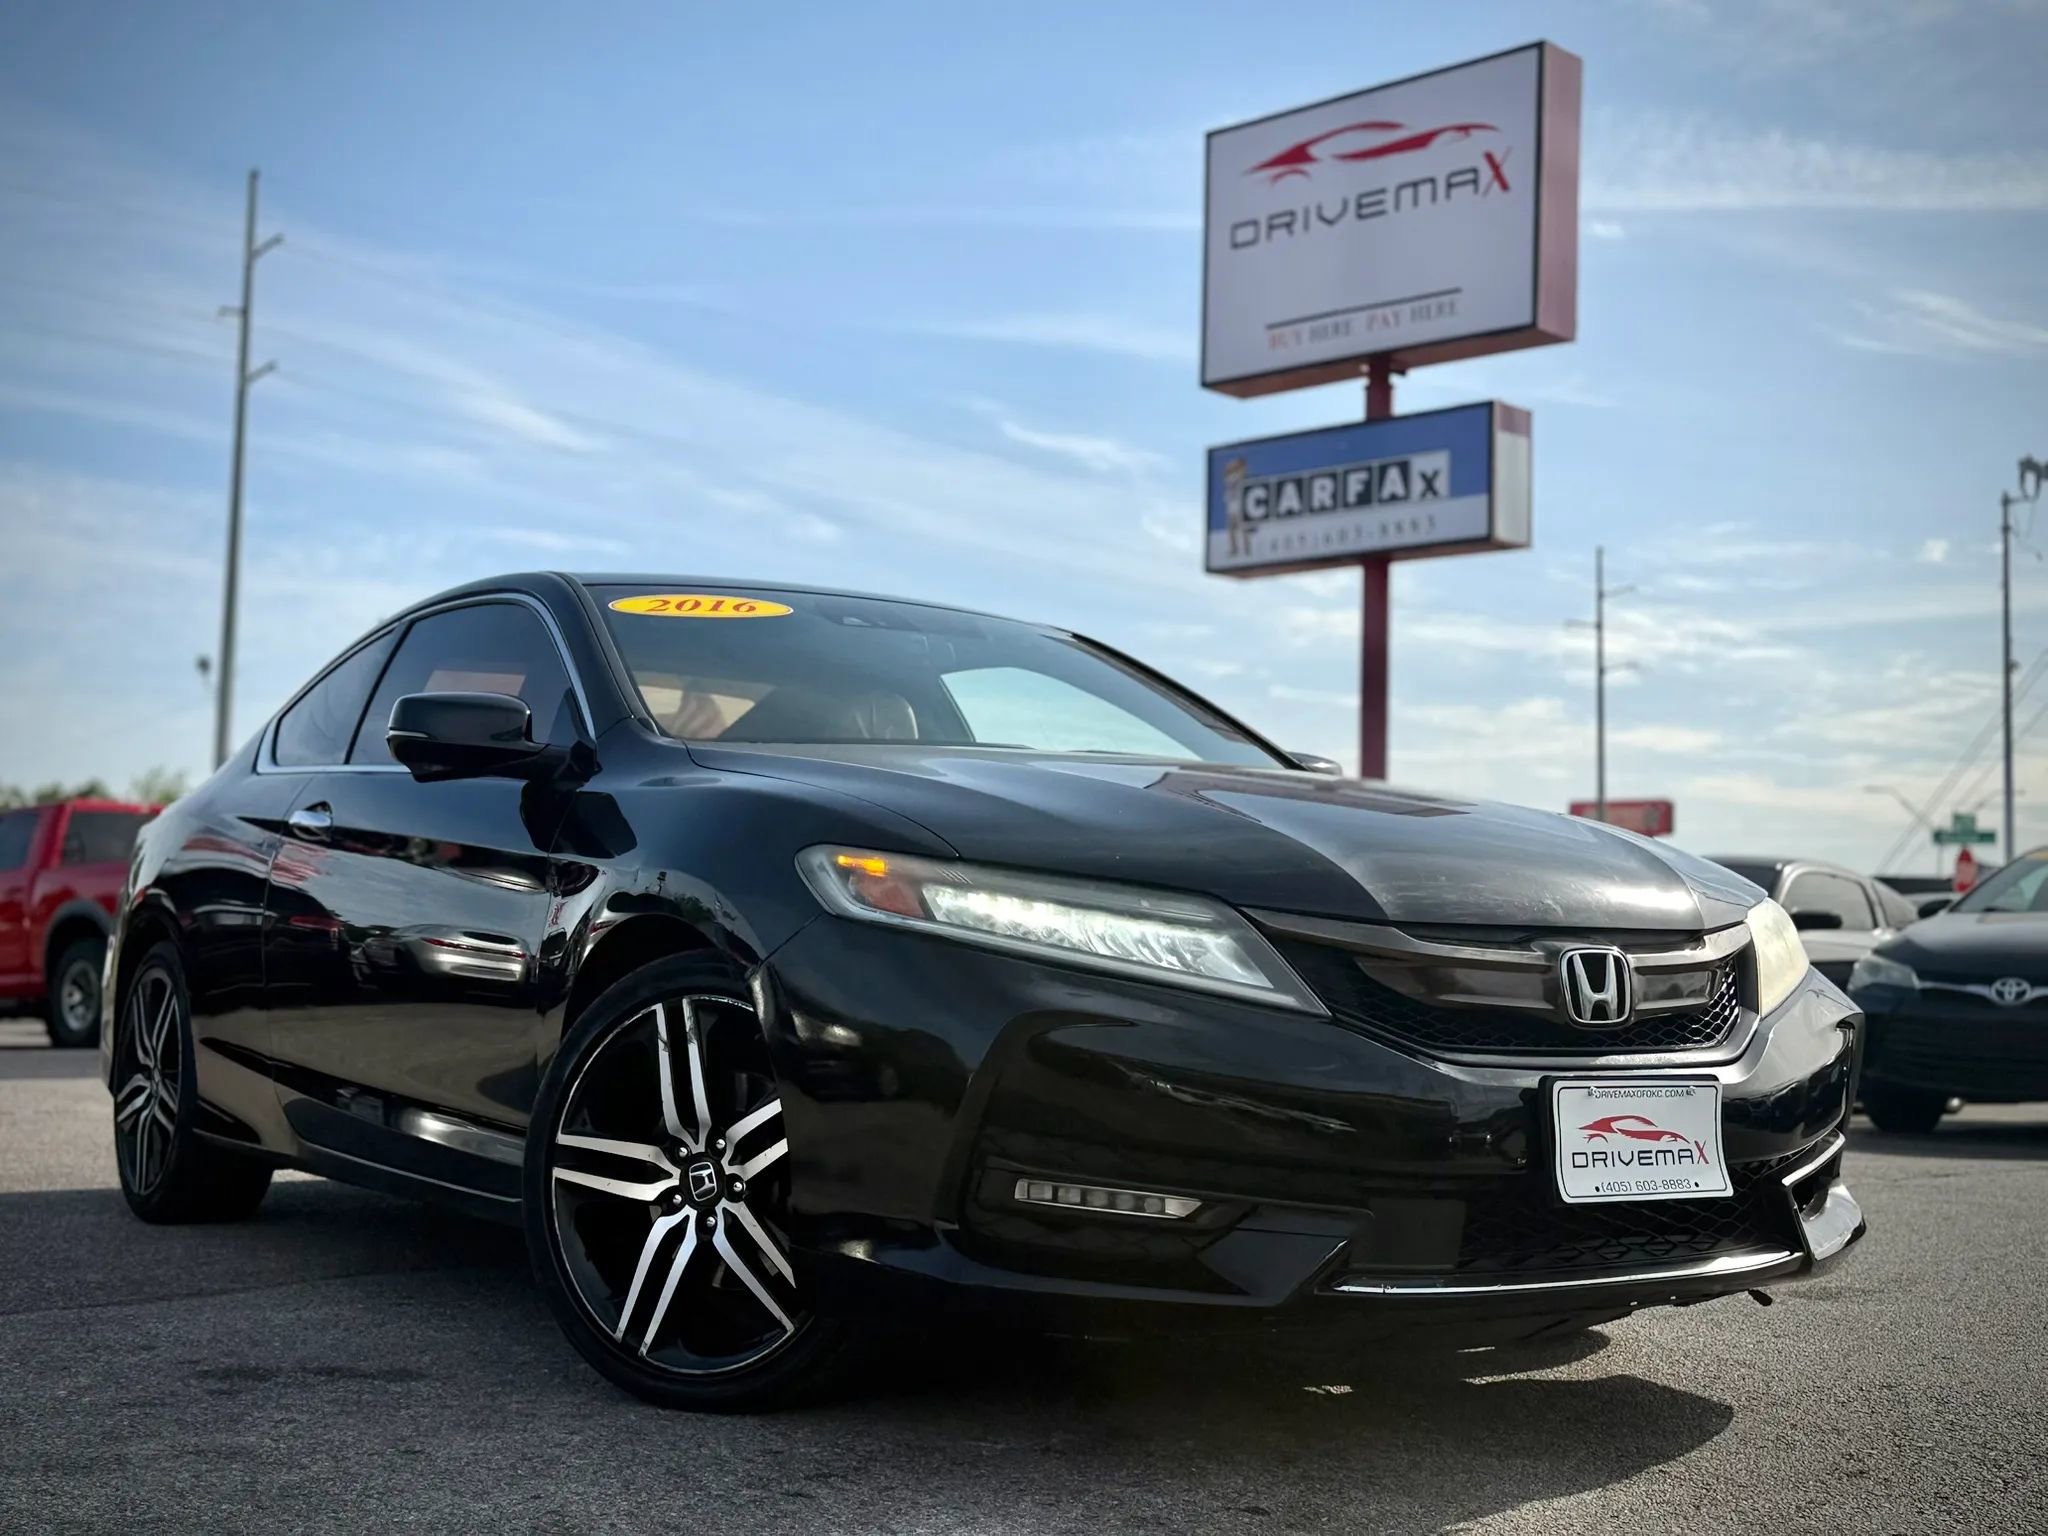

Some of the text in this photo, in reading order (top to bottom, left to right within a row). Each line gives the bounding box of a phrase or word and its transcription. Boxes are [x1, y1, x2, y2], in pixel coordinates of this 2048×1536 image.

[1230, 148, 1512, 250] DRIVEMAX
[1366, 309, 1402, 332] PAY
[1410, 299, 1458, 322] HERE
[1245, 464, 1440, 520] CARFAX
[645, 599, 757, 613] 2016
[1571, 1140, 1710, 1169] DRIVEMAX
[1601, 1178, 1693, 1193] (405) 603-8883
